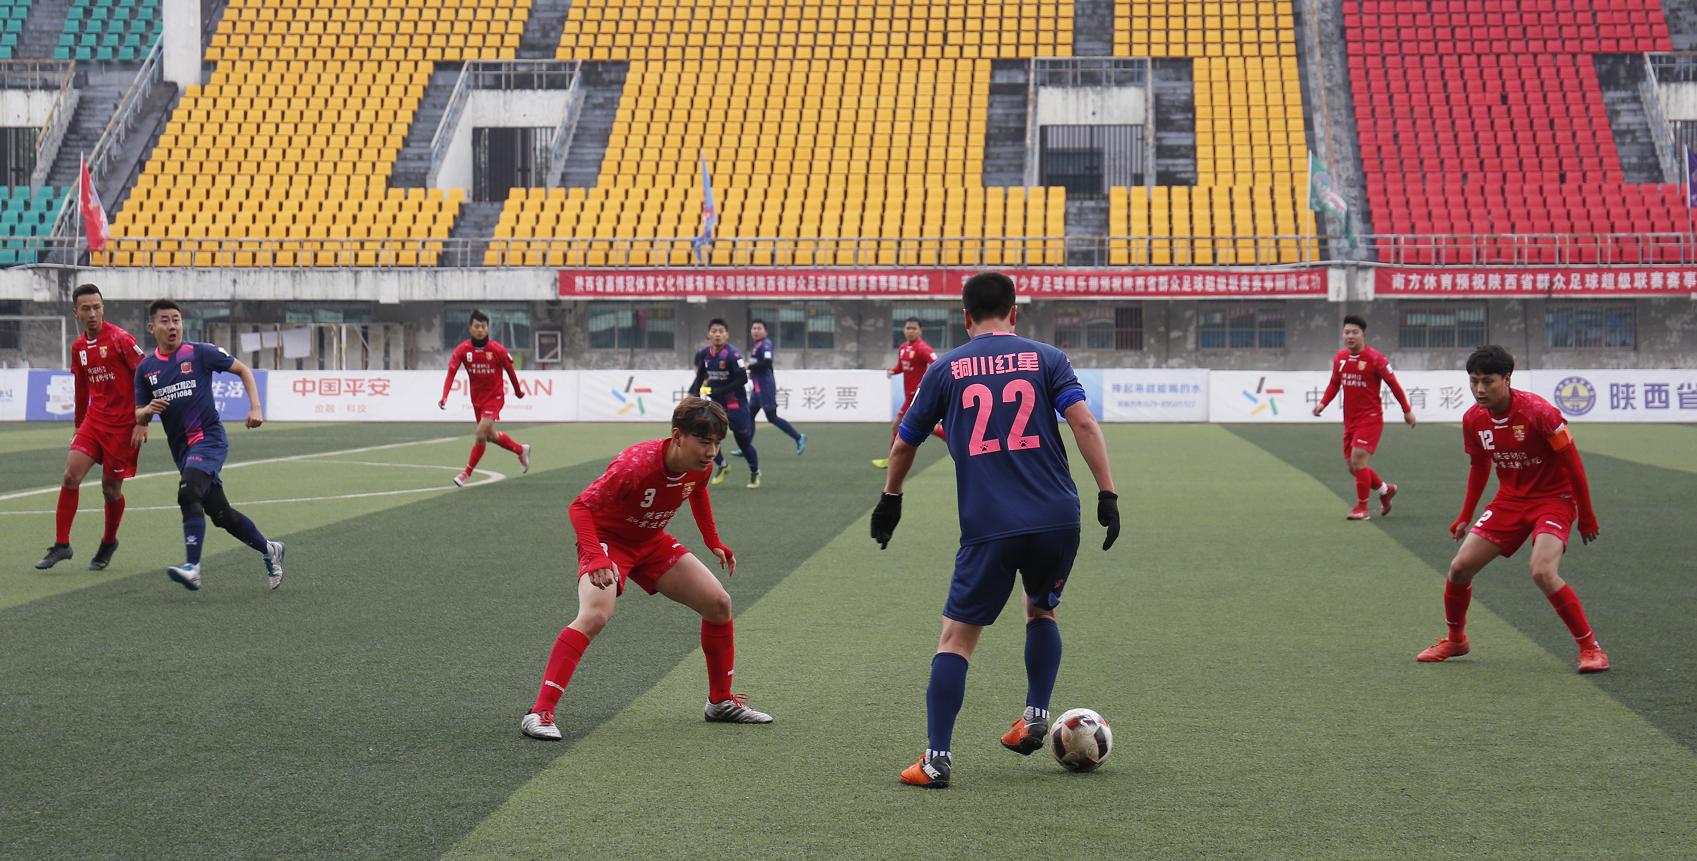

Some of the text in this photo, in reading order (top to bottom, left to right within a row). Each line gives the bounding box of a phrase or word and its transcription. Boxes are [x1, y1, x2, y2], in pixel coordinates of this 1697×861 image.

[950, 351, 1040, 380] 铜川红星
[1339, 359, 1347, 372] 7
[148, 374, 158, 386] 15
[292, 377, 391, 397] 中国平安
[1609, 383, 1697, 411] 陕西省
[961, 379, 1041, 456] 22
[1477, 429, 1496, 450] 12
[639, 488, 657, 508] 3
[922, 763, 942, 780] NIKE
